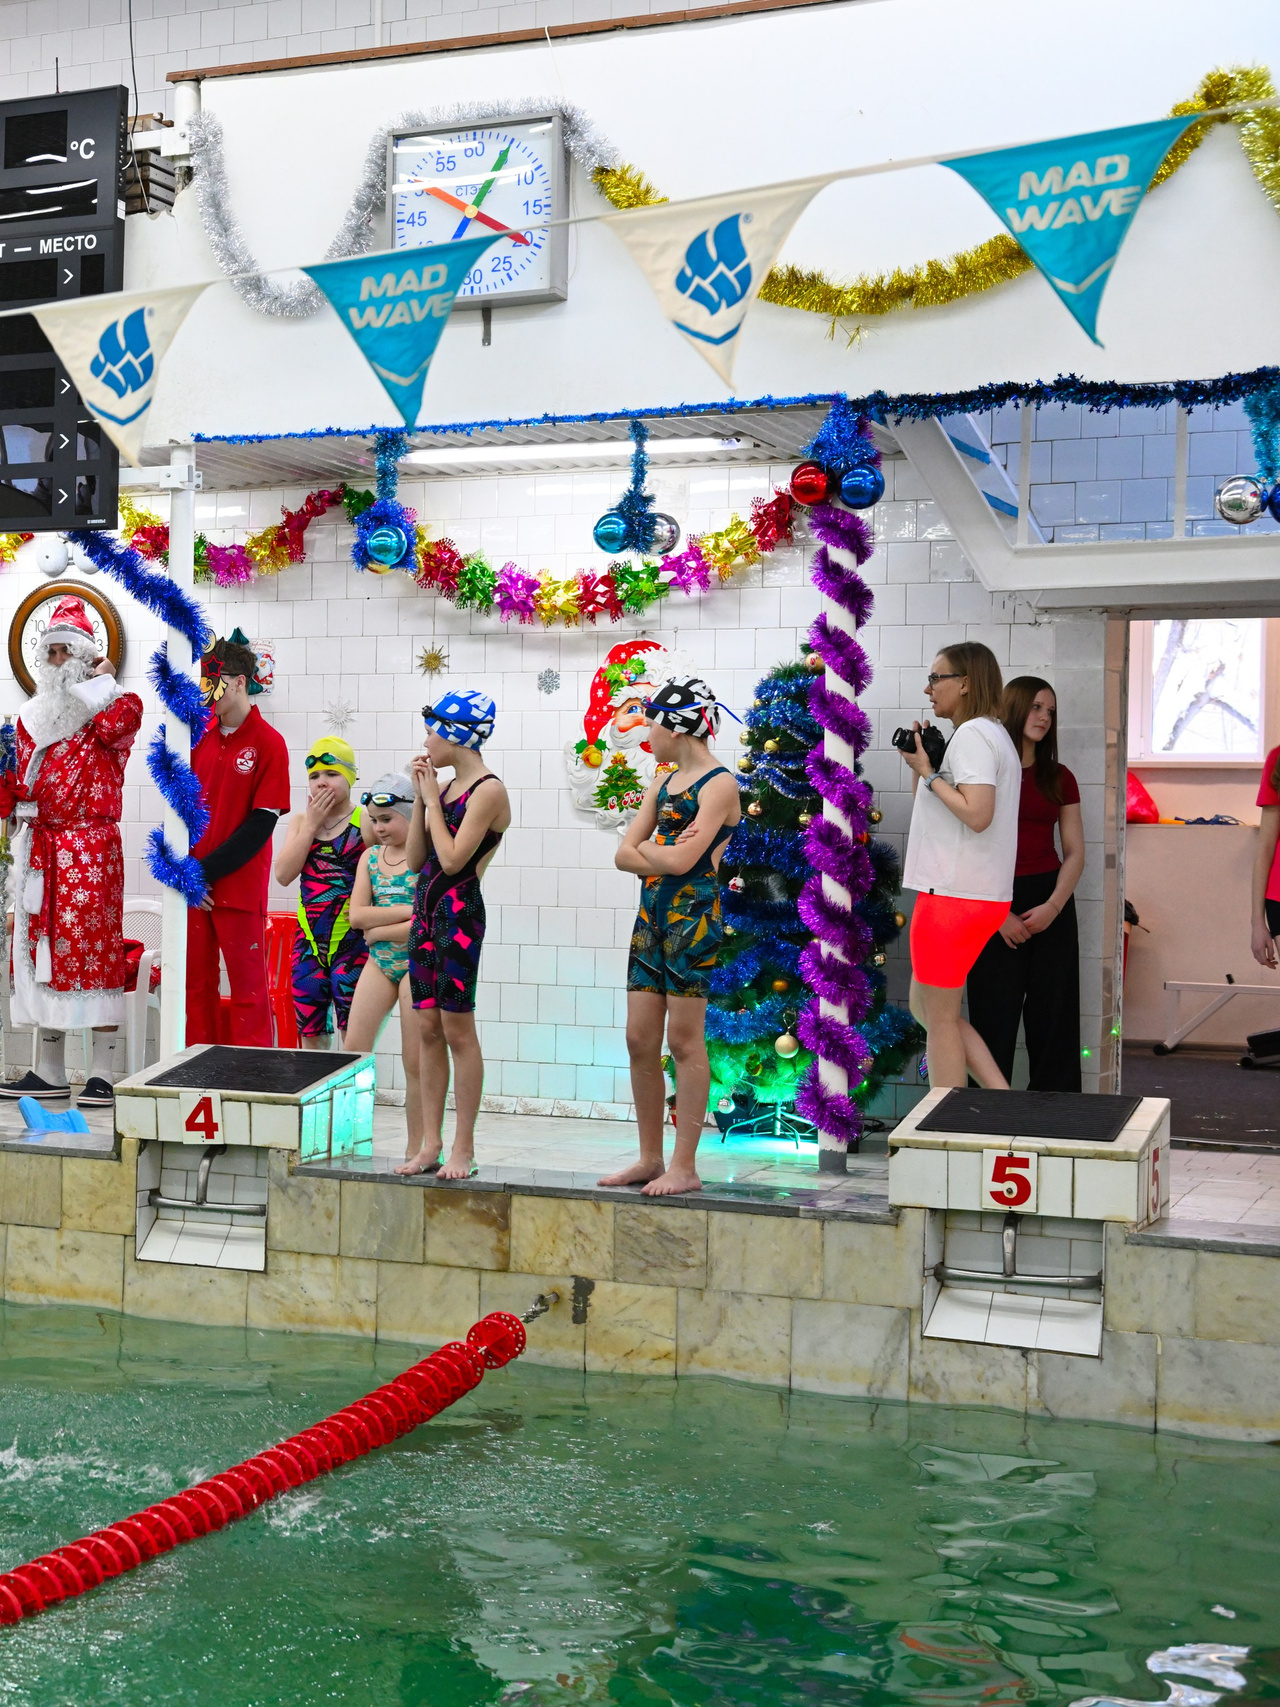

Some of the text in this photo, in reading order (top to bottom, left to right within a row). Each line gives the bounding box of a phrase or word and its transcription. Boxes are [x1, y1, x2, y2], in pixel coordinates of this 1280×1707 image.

[464, 141, 485, 157] 60
[435, 155, 456, 172] 55
[516, 170, 534, 186] 10
[1018, 154, 1131, 201] MAD
[522, 199, 543, 216] 15
[1006, 185, 1143, 234] WAVE
[406, 211, 427, 227] 45
[39, 234, 97, 255] МЕСТО
[491, 255, 512, 273] 25
[360, 263, 448, 301] MAD
[348, 291, 454, 330] WAVE
[30, 637, 38, 650] 9
[185, 1096, 219, 1140] 4
[989, 1155, 1032, 1207] 5
[1149, 1146, 1160, 1213] 5
